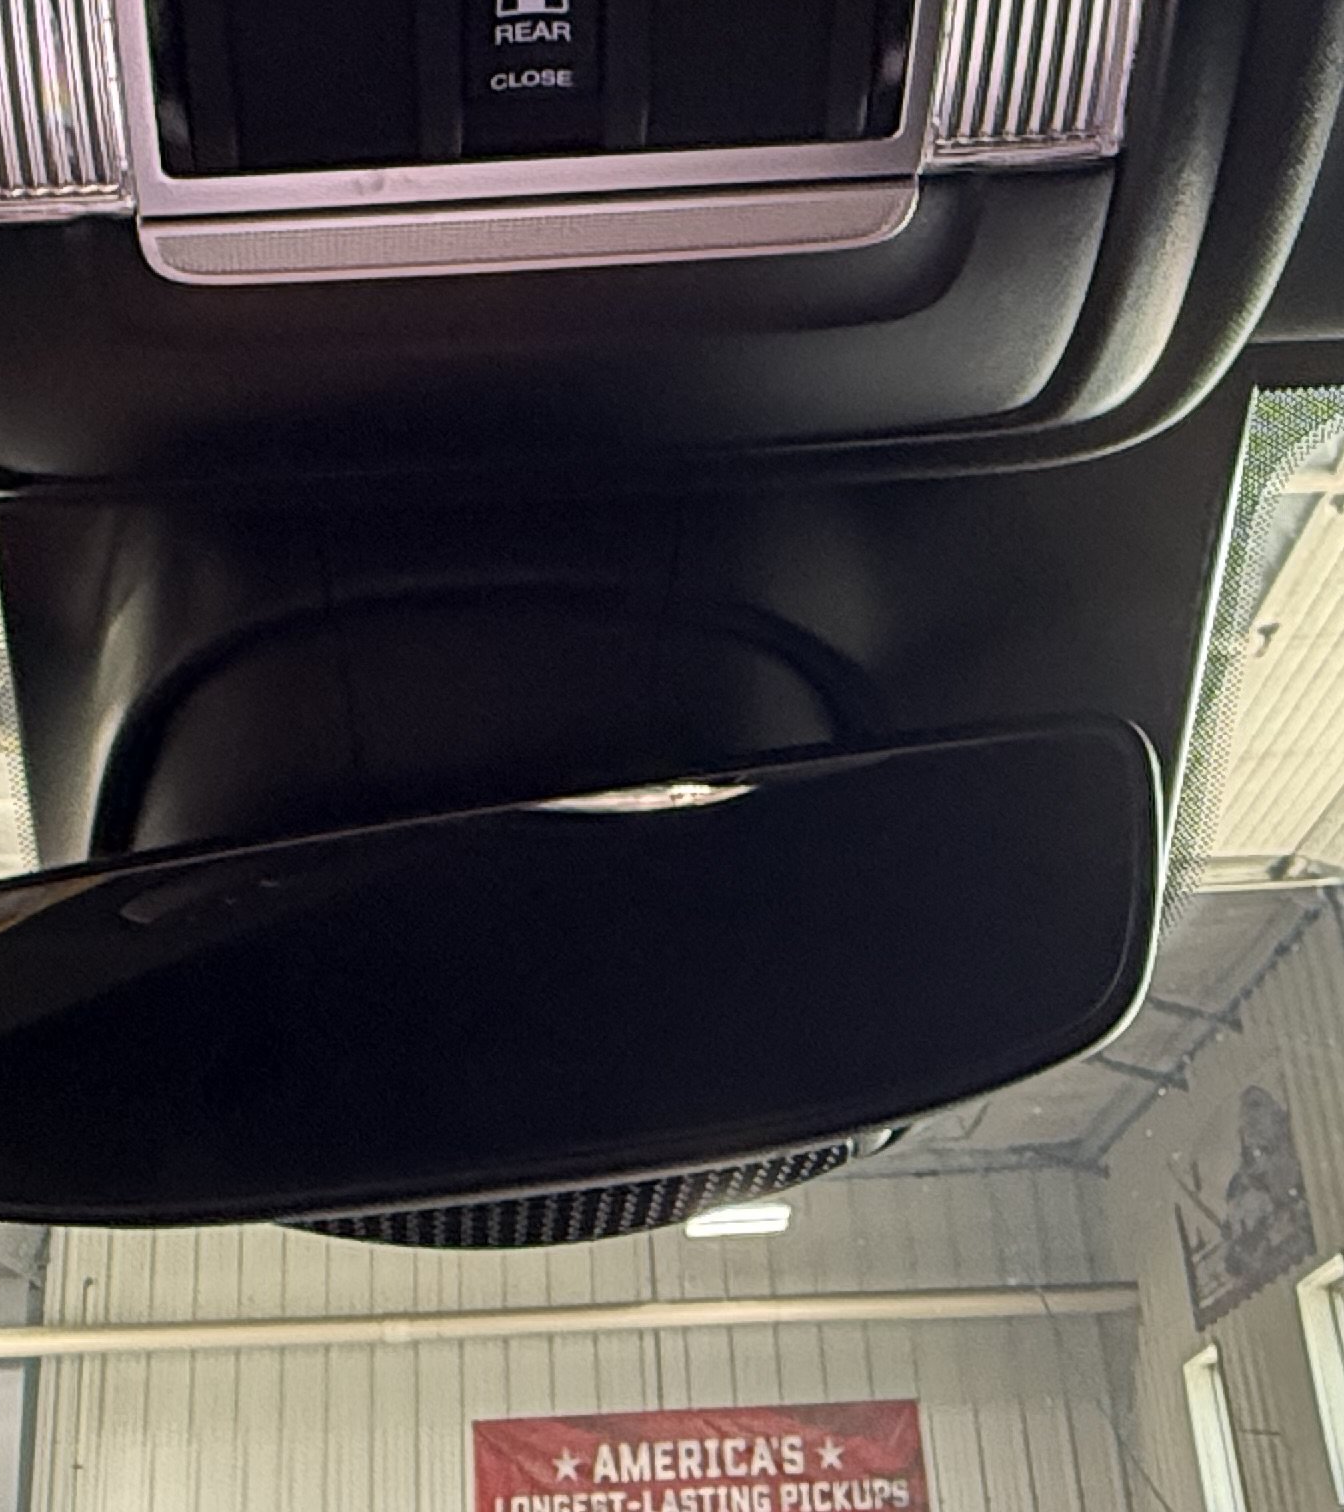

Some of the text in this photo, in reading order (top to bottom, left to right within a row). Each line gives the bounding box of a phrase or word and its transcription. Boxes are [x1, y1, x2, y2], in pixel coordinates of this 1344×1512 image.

[495, 20, 571, 45] REAR
[490, 69, 573, 91] CLOSE
[593, 1435, 805, 1484] AMERICA'S
[780, 1477, 910, 1512] PICKUPS
